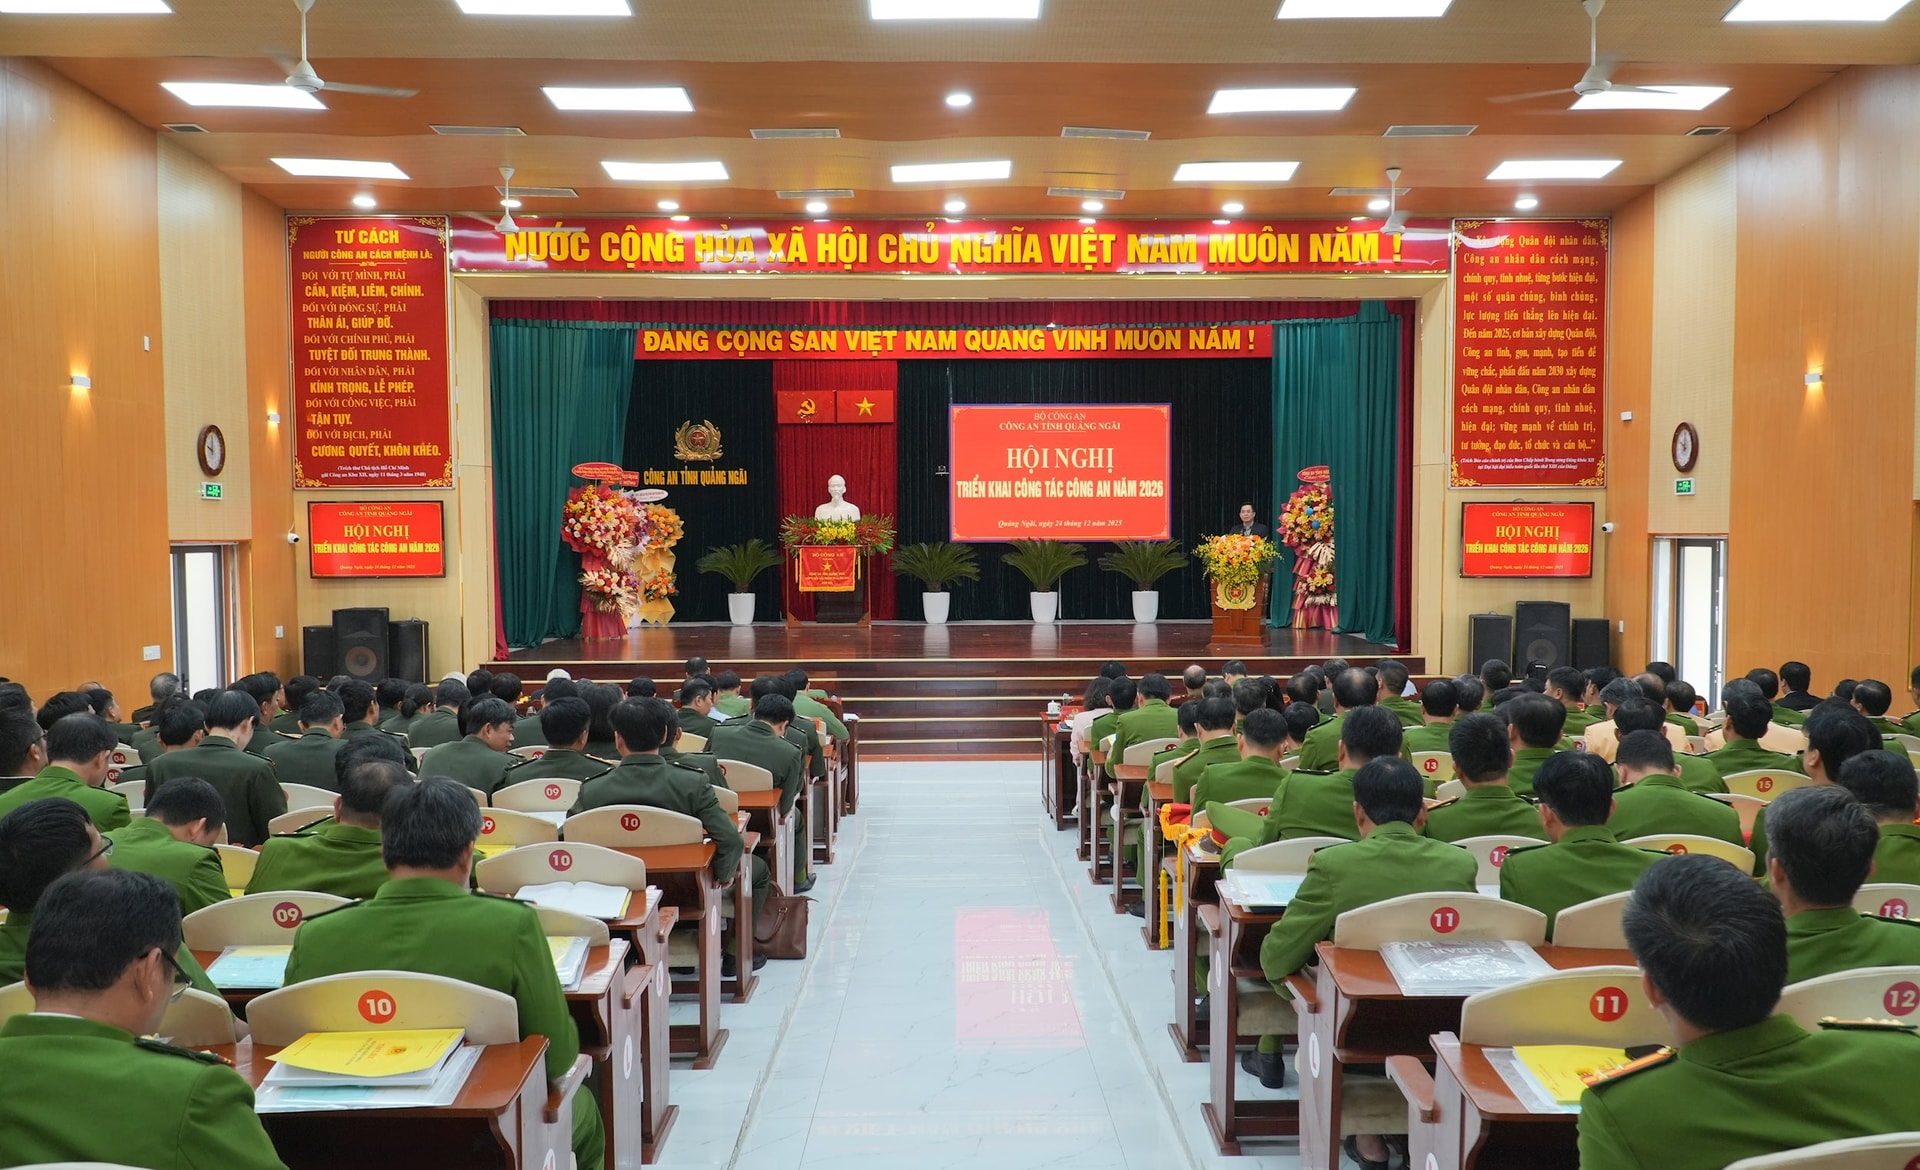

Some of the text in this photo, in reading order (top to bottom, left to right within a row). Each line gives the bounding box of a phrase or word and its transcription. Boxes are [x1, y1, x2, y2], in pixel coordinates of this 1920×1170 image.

[335, 227, 399, 244] TƯ CÁCH
[505, 222, 590, 261] NƯỚC
[600, 225, 684, 268] CỘNG
[696, 224, 756, 263] HÒA
[767, 227, 809, 263] XÃ
[818, 226, 867, 270] HỘI
[878, 222, 939, 264] CHỦ
[950, 227, 1042, 264] NGHĨA
[1049, 224, 1116, 270] VIỆT
[1128, 234, 1196, 263] NAM
[1209, 226, 1299, 263] MUÔN
[1310, 226, 1378, 263] NĂM
[331, 249, 354, 259] CÔNG
[355, 251, 368, 259] AN
[369, 249, 392, 259] CÁCH
[394, 249, 418, 260] MỆNH
[420, 249, 432, 259] LÀ:
[307, 314, 394, 330] THÂN ÁI, GIÚP ĐỠ.
[905, 330, 956, 351] NAM
[964, 329, 1045, 352] QUANG
[1052, 329, 1106, 350] VINH
[1249, 330, 1254, 350] !
[309, 346, 430, 362] TUYỆT ĐỐI TRUNG THÀNH.
[310, 378, 415, 396] KÍNH TRỌNG, LỄ PHÉP.
[310, 412, 352, 427] TẬN TỤY.
[1034, 411, 1086, 422] BỘ CÔNG AN
[999, 421, 1025, 430] CÔNG
[1027, 422, 1038, 430] AN
[1098, 421, 1120, 430] NGÃI
[312, 444, 345, 457] CƯƠNG
[349, 442, 381, 458] QUYẾT,
[383, 442, 410, 456] KHÔN
[1007, 444, 1113, 474] HỘI NGHỊ
[644, 467, 665, 485] CÔNG
[666, 470, 678, 485] AN
[680, 465, 698, 485] TỈNH
[700, 465, 726, 486] QUẢNG
[728, 468, 747, 485] NGÃI
[956, 474, 1164, 498] TRIỂN KHAI CÔNG TÁC CÔNG AN NĂM 2026
[344, 524, 409, 540] HỘI NGHỊ
[1496, 524, 1559, 540] HỘI NGHỊ
[1426, 762, 1437, 770] 13
[545, 787, 560, 797] 09
[1758, 780, 1772, 789] 15
[623, 818, 639, 827] 10
[552, 855, 570, 867] 10
[276, 907, 300, 923] 09
[1884, 904, 1904, 918] 13
[1434, 912, 1454, 927] 11
[1595, 995, 1624, 1014] 11
[1890, 990, 1916, 1008] 12
[366, 998, 392, 1017] 10
